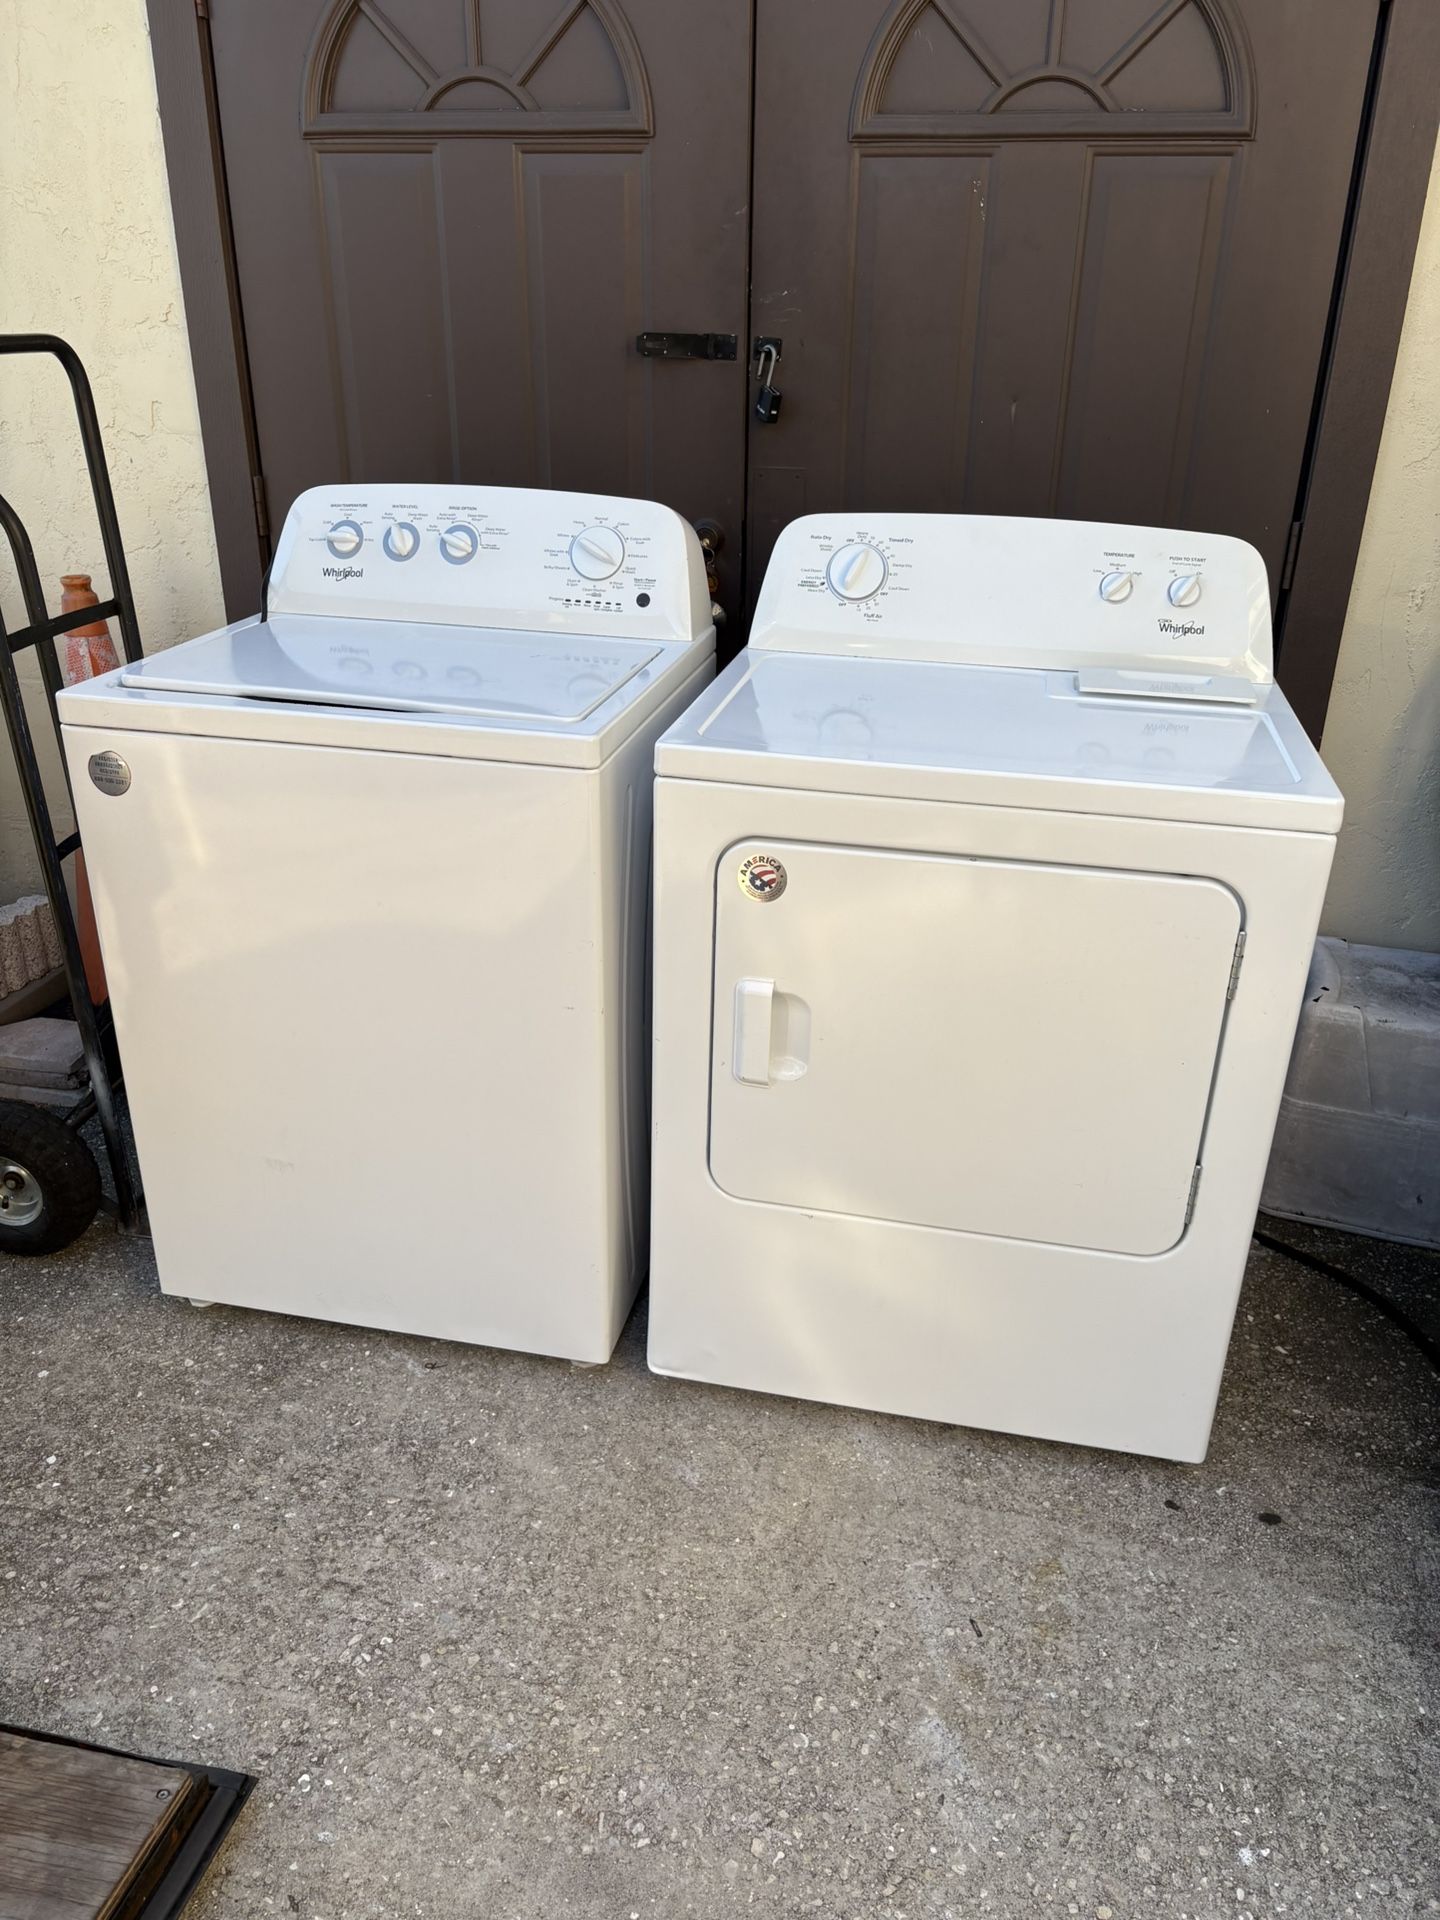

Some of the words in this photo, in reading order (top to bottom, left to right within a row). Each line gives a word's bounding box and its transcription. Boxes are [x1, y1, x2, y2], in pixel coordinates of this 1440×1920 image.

[322, 567, 363, 580] Whirlpool
[1159, 622, 1205, 637] Whirlpool
[740, 856, 781, 877] AMERICA
